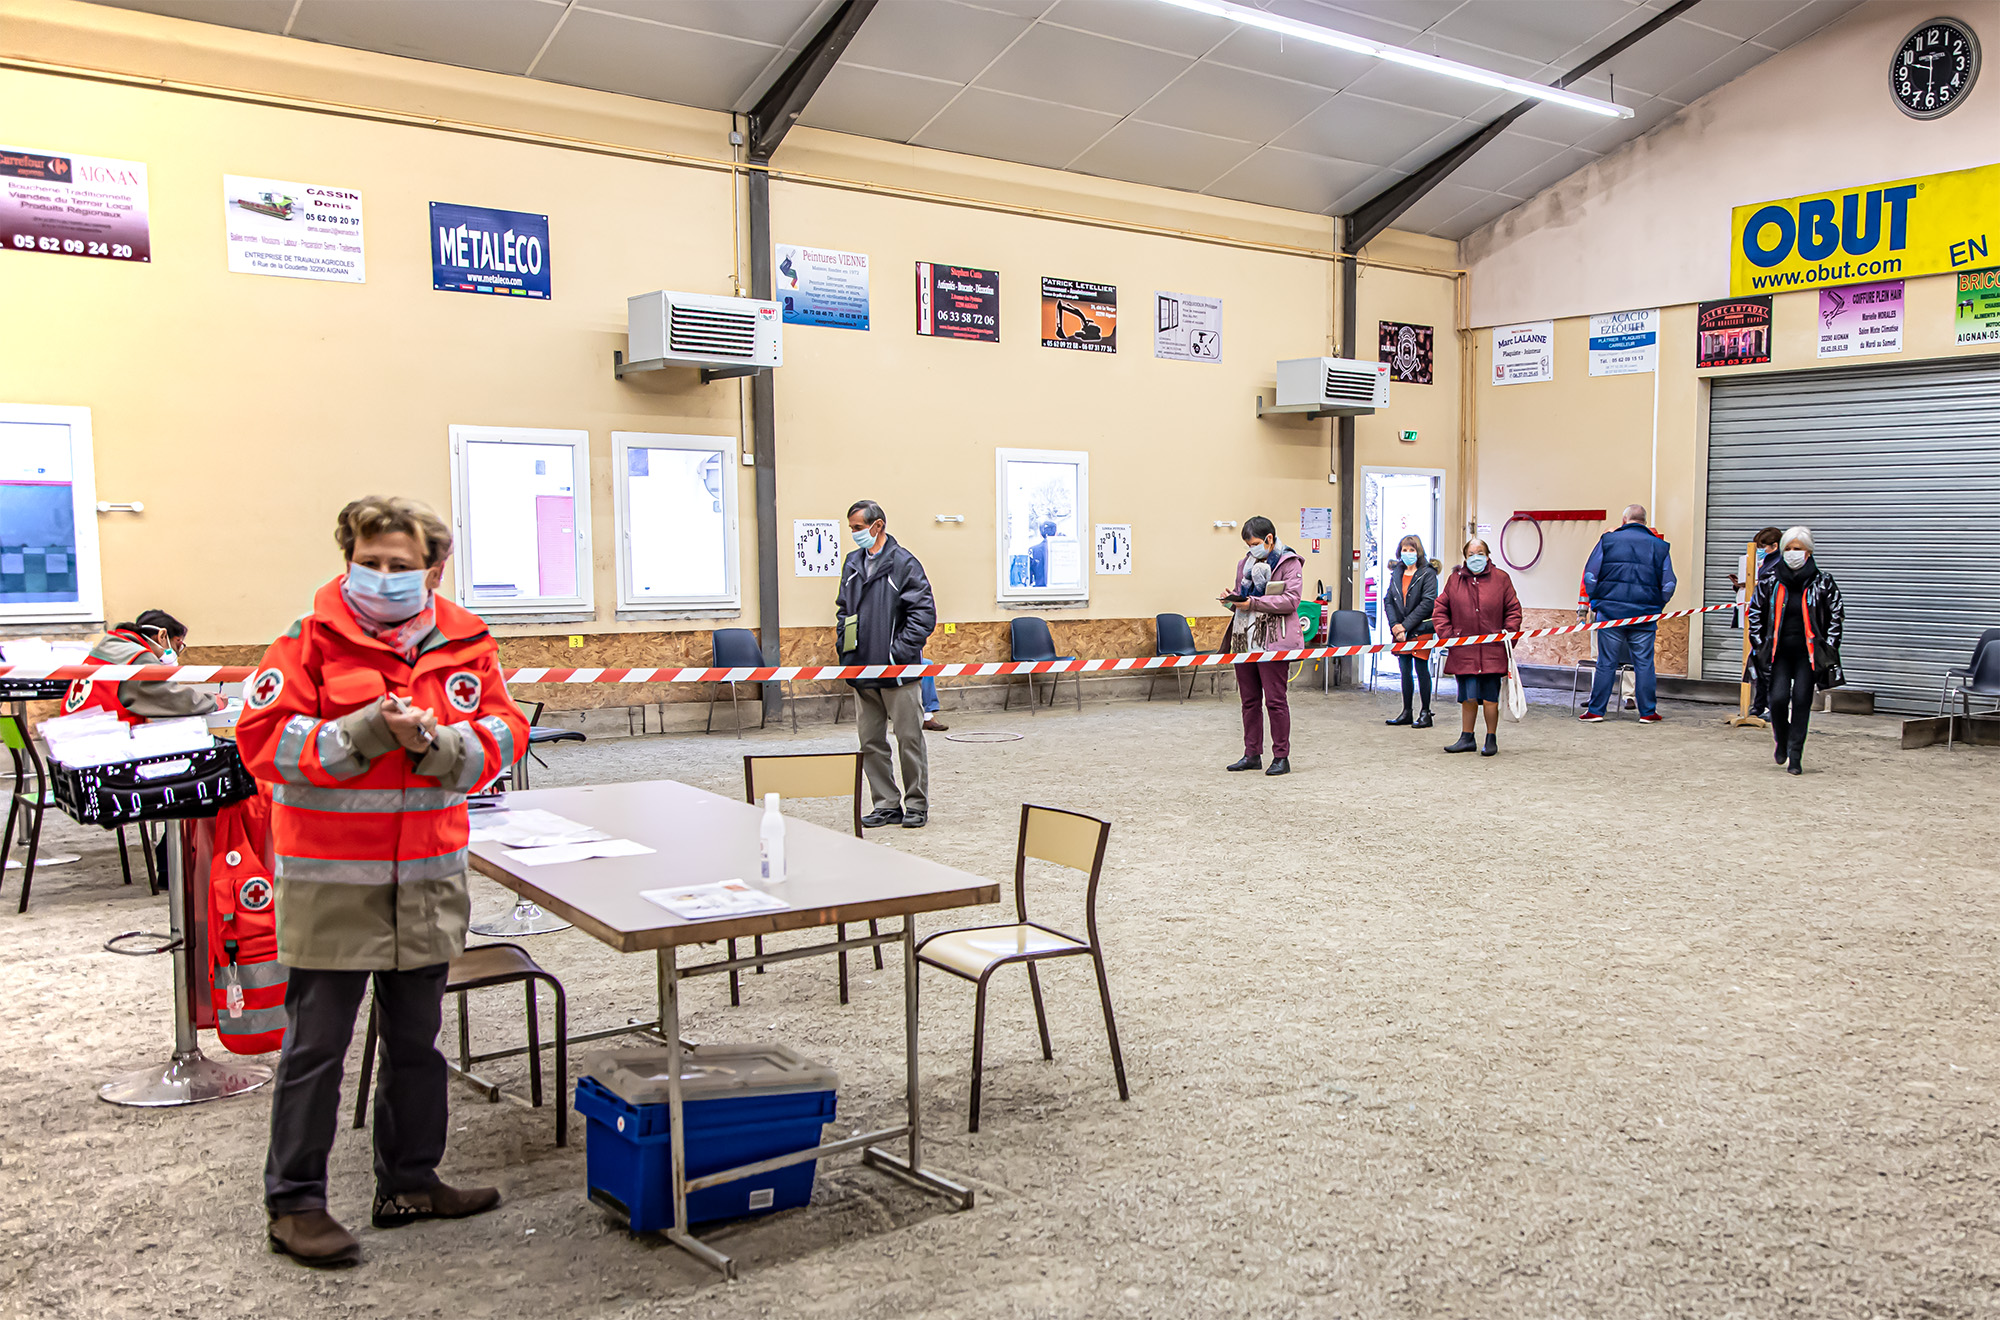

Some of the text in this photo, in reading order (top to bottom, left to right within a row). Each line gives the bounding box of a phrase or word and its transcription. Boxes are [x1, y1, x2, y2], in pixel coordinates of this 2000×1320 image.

[1916, 37, 1923, 52] 11
[1928, 30, 1939, 45] 12
[1945, 31, 1949, 46] 1
[1953, 40, 1962, 55] 2
[1904, 50, 1913, 65] 10
[1956, 56, 1965, 70] 3
[1899, 67, 1908, 81] 9
[1951, 73, 1960, 87] 4
[1902, 81, 1911, 96] 8
[1940, 86, 1949, 101] 5
[1912, 91, 1922, 106] 7
[1926, 93, 1934, 107] 6
[80, 166, 138, 185] AIGNAN
[9, 192, 51, 202] Viandes
[71, 198, 103, 208] Terroir
[107, 201, 133, 210] Local
[66, 188, 132, 201] Traditionnelle
[306, 188, 359, 200] CASSIN
[21, 202, 63, 212] Produits
[314, 200, 351, 210] Denis
[317, 214, 326, 222] 62
[328, 216, 338, 224] 09
[1743, 184, 1917, 268] OBUT
[14, 234, 132, 258] 05 62 09 24 20
[439, 223, 542, 275] MÉTALÉCO
[1949, 234, 1989, 267] EN
[245, 251, 282, 261] ENTREPRISE
[294, 256, 320, 264] TRAVAUX
[321, 259, 355, 268] AGRICOLES
[803, 249, 867, 267] Peintures VIENNE
[327, 266, 349, 275] AIGNAN
[1752, 257, 1902, 290] www.obut.com
[467, 273, 523, 286] www.metaleco.com
[1042, 278, 1113, 292] PATRICK LETELLIER
[1852, 289, 1902, 304] COIFFURE PLEIN HAIR
[938, 310, 994, 325] 06 33 58 72 06
[1612, 311, 1648, 323] ACACIO
[1498, 335, 1547, 349] Marc LALANNE
